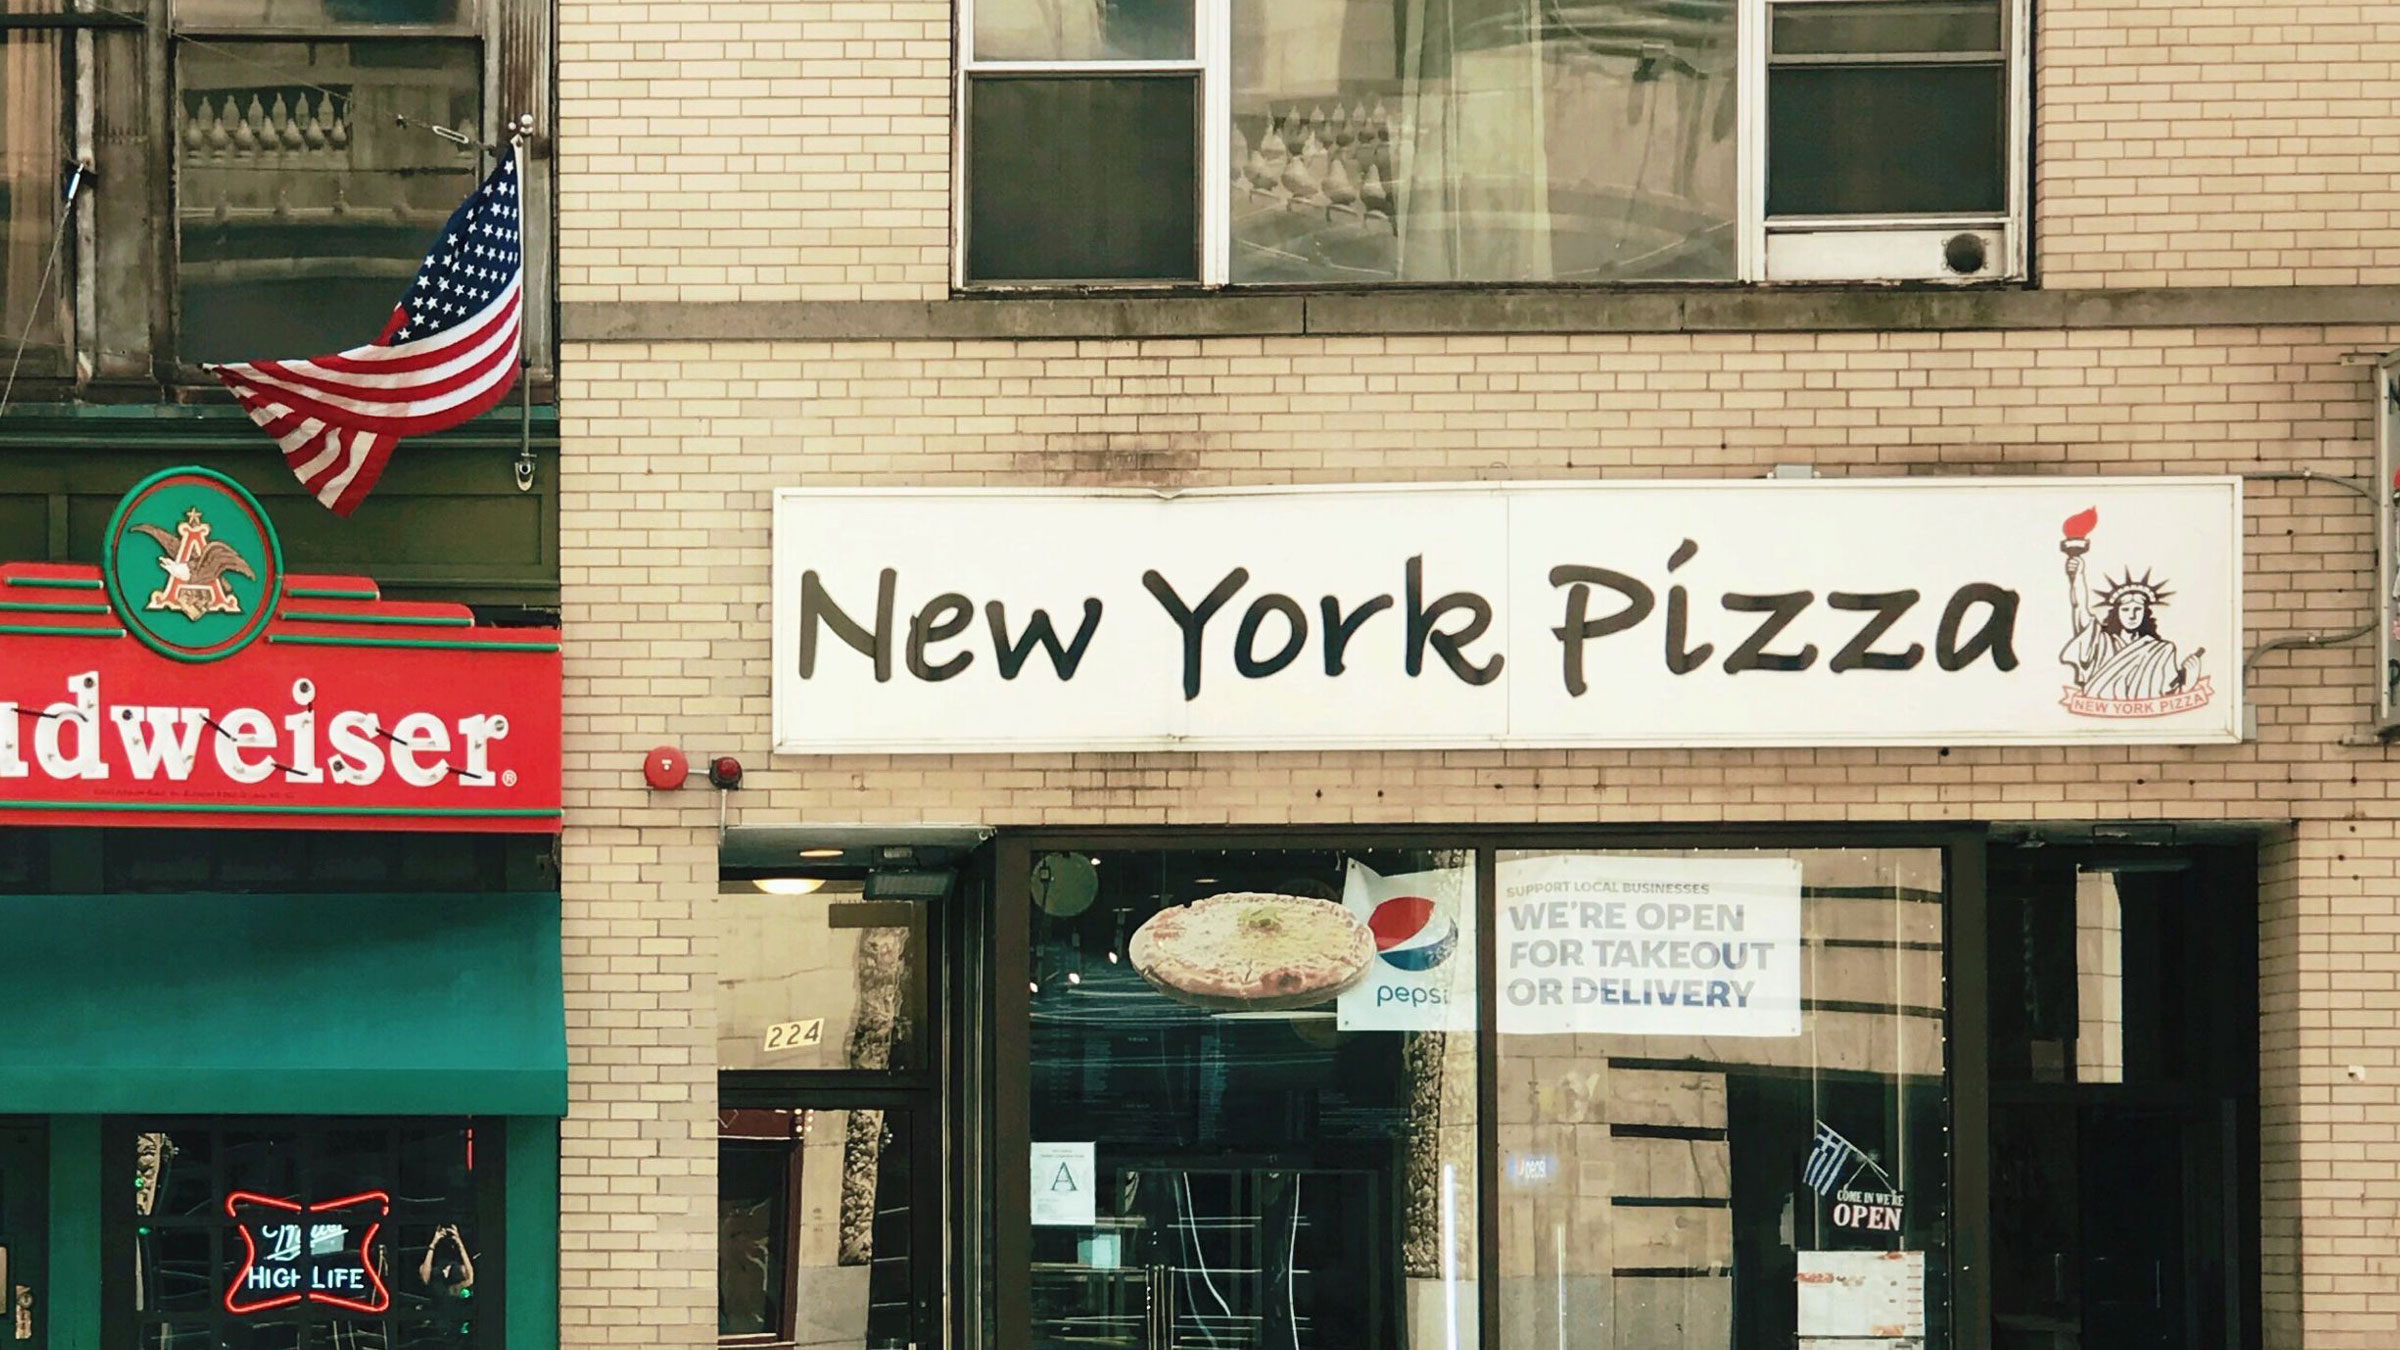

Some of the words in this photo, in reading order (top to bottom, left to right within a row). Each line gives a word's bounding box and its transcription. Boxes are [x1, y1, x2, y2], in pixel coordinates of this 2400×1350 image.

[799, 567, 1102, 683] New
[1142, 554, 1505, 702] York
[1549, 538, 2020, 698] Pizza
[2074, 699, 2109, 712] NEW
[2113, 702, 2153, 714] YORK
[2159, 693, 2204, 710] PIZZA
[1506, 881, 1571, 898] SUPPORT
[1573, 881, 1619, 893] LOCAL
[1622, 882, 1710, 895] BUSINESSES
[1509, 901, 1627, 931] WE'RE
[1636, 902, 1745, 932] OPEN
[1509, 939, 1584, 969] FOR
[1592, 939, 1775, 970] TAKEOUT
[1377, 985, 1449, 1007] pepsi
[1506, 977, 1564, 1006] OR
[1572, 976, 1756, 1008] DELIVERY
[768, 1020, 820, 1048] 224
[1050, 1161, 1079, 1191] A
[1837, 1190, 1863, 1203] COME
[1864, 1192, 1875, 1203] IN
[1833, 1203, 1902, 1231] OPEN
[311, 1265, 365, 1289] LIFE
